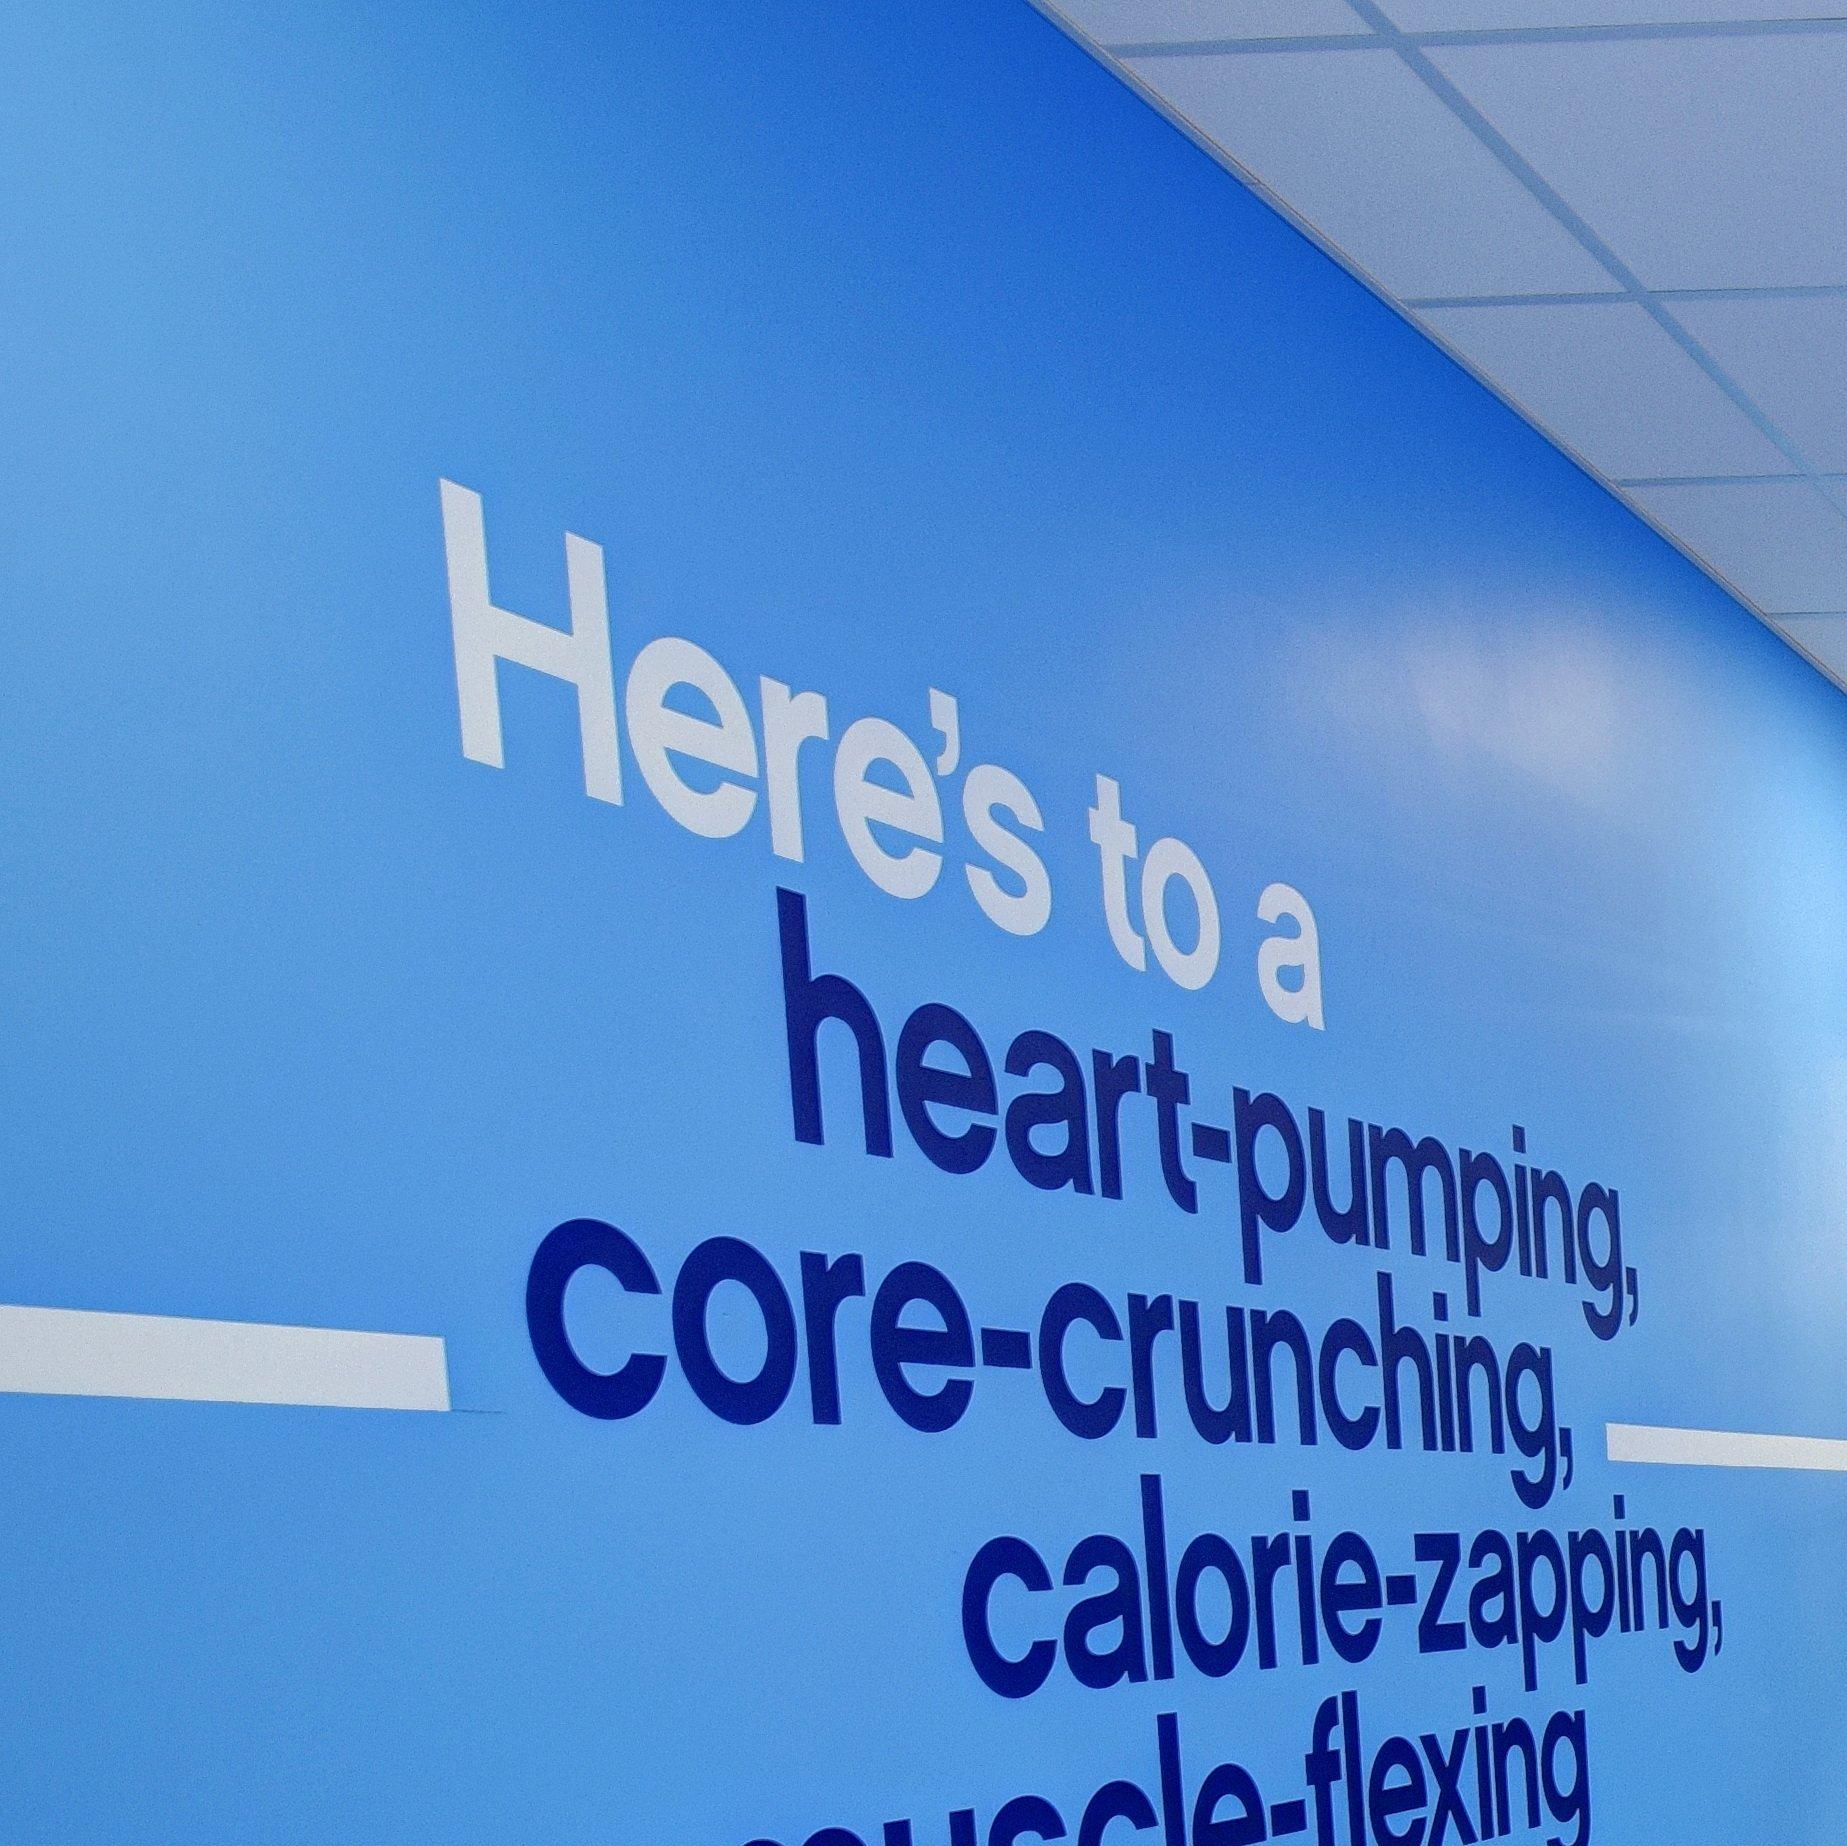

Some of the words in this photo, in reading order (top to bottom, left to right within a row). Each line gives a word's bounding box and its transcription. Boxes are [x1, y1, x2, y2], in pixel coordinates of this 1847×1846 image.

[440, 478, 1052, 936] Here's
[1089, 775, 1220, 991] to
[1258, 884, 1325, 1030] a
[775, 886, 1640, 1341] heart-pumping,
[526, 1217, 1573, 1509] core-crunching,
[962, 1473, 1723, 1698] calorie-zapping,
